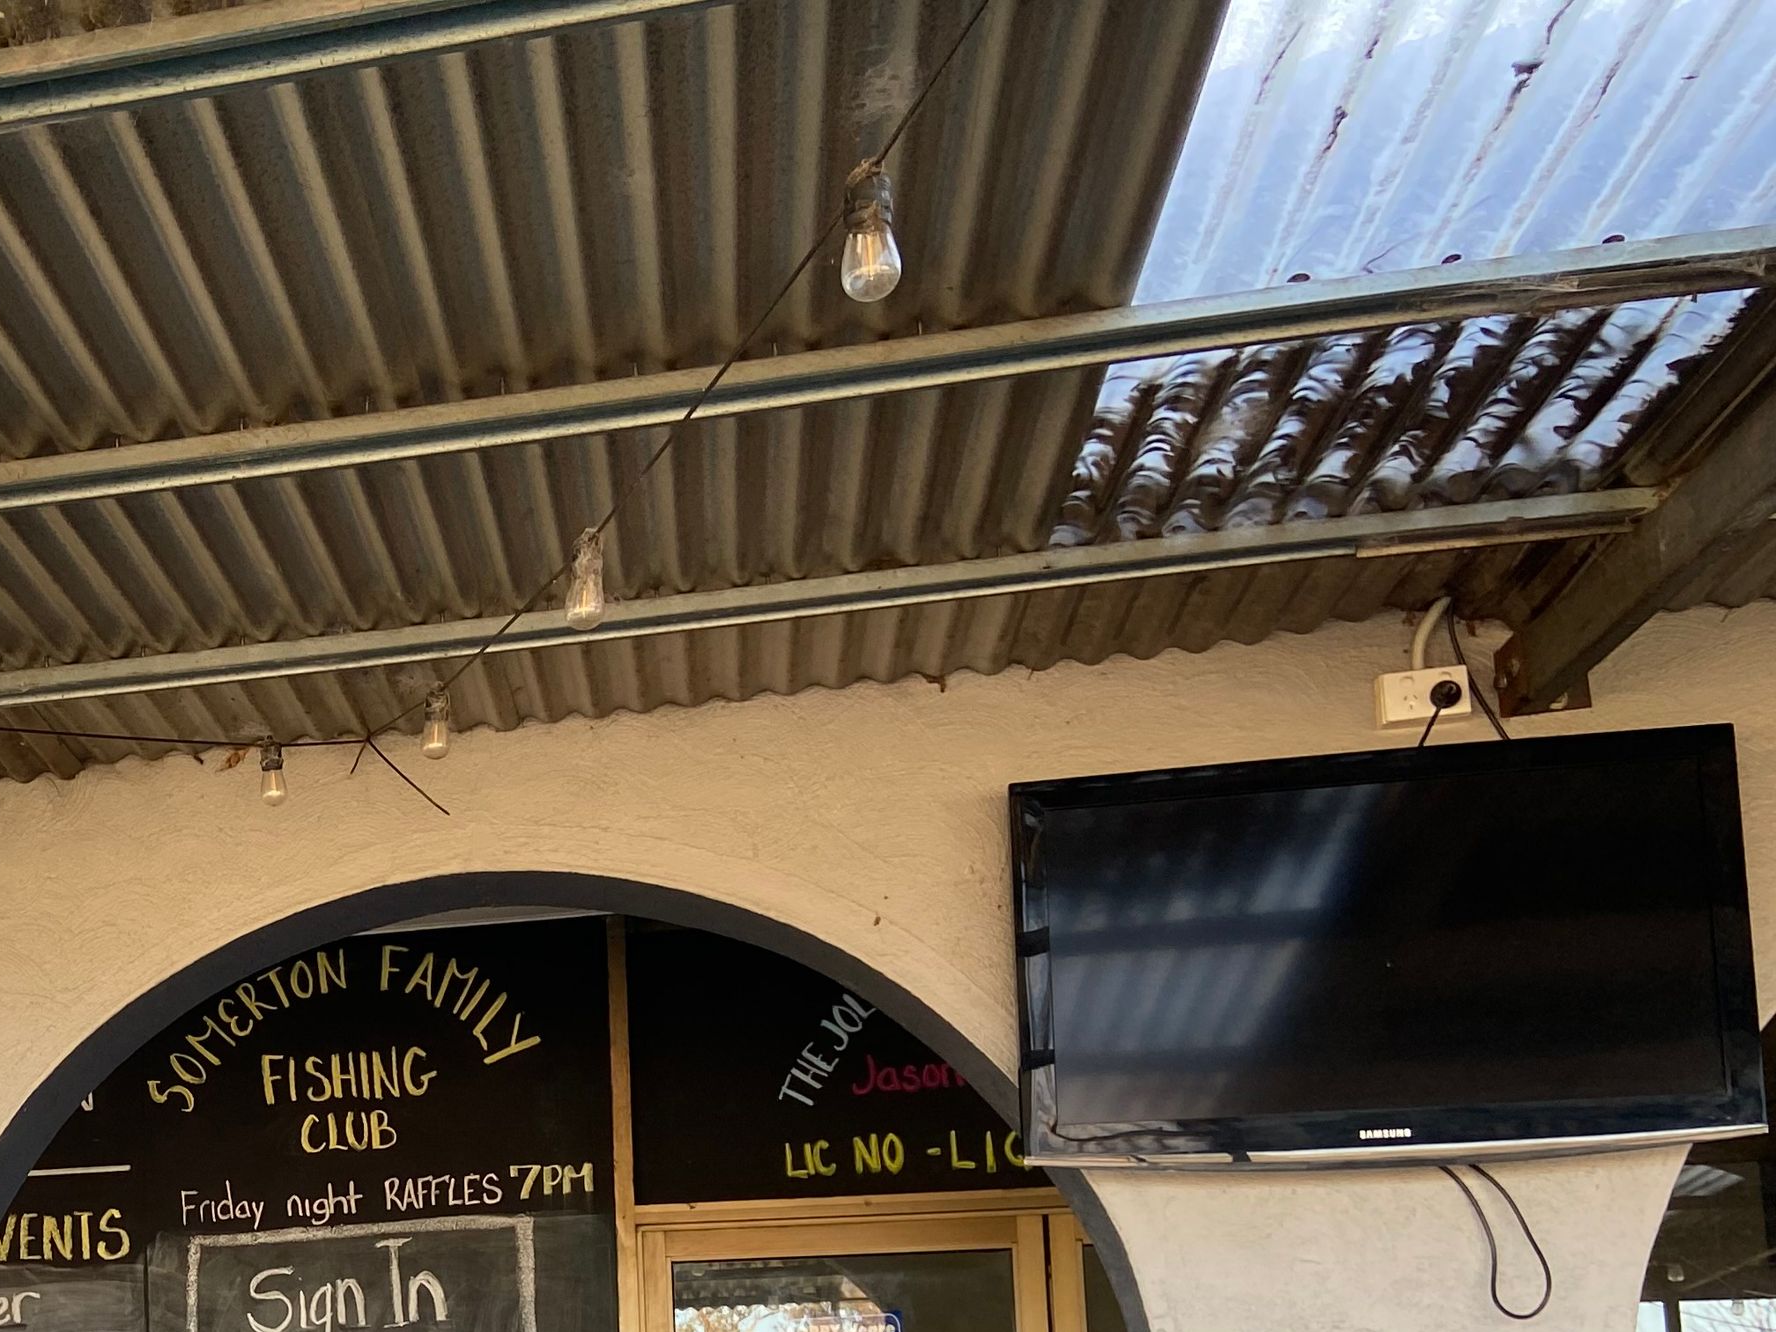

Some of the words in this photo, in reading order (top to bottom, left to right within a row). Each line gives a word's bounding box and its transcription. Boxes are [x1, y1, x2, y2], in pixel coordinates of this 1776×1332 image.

[147, 949, 347, 1112] SOMERTON
[380, 945, 541, 1065] FAMILY
[261, 1046, 437, 1105] FISHING
[778, 1041, 840, 1107] THE
[300, 1109, 397, 1153] CLUB
[785, 1140, 837, 1180] LIC
[852, 1132, 905, 1175] NO
[1359, 1128, 1412, 1140] SAMSUNG
[181, 1180, 265, 1230] Friday
[287, 1181, 363, 1225] night
[384, 1172, 503, 1212] RAFFLES
[510, 1162, 594, 1199] 7PM
[376, 1237, 449, 1329] In
